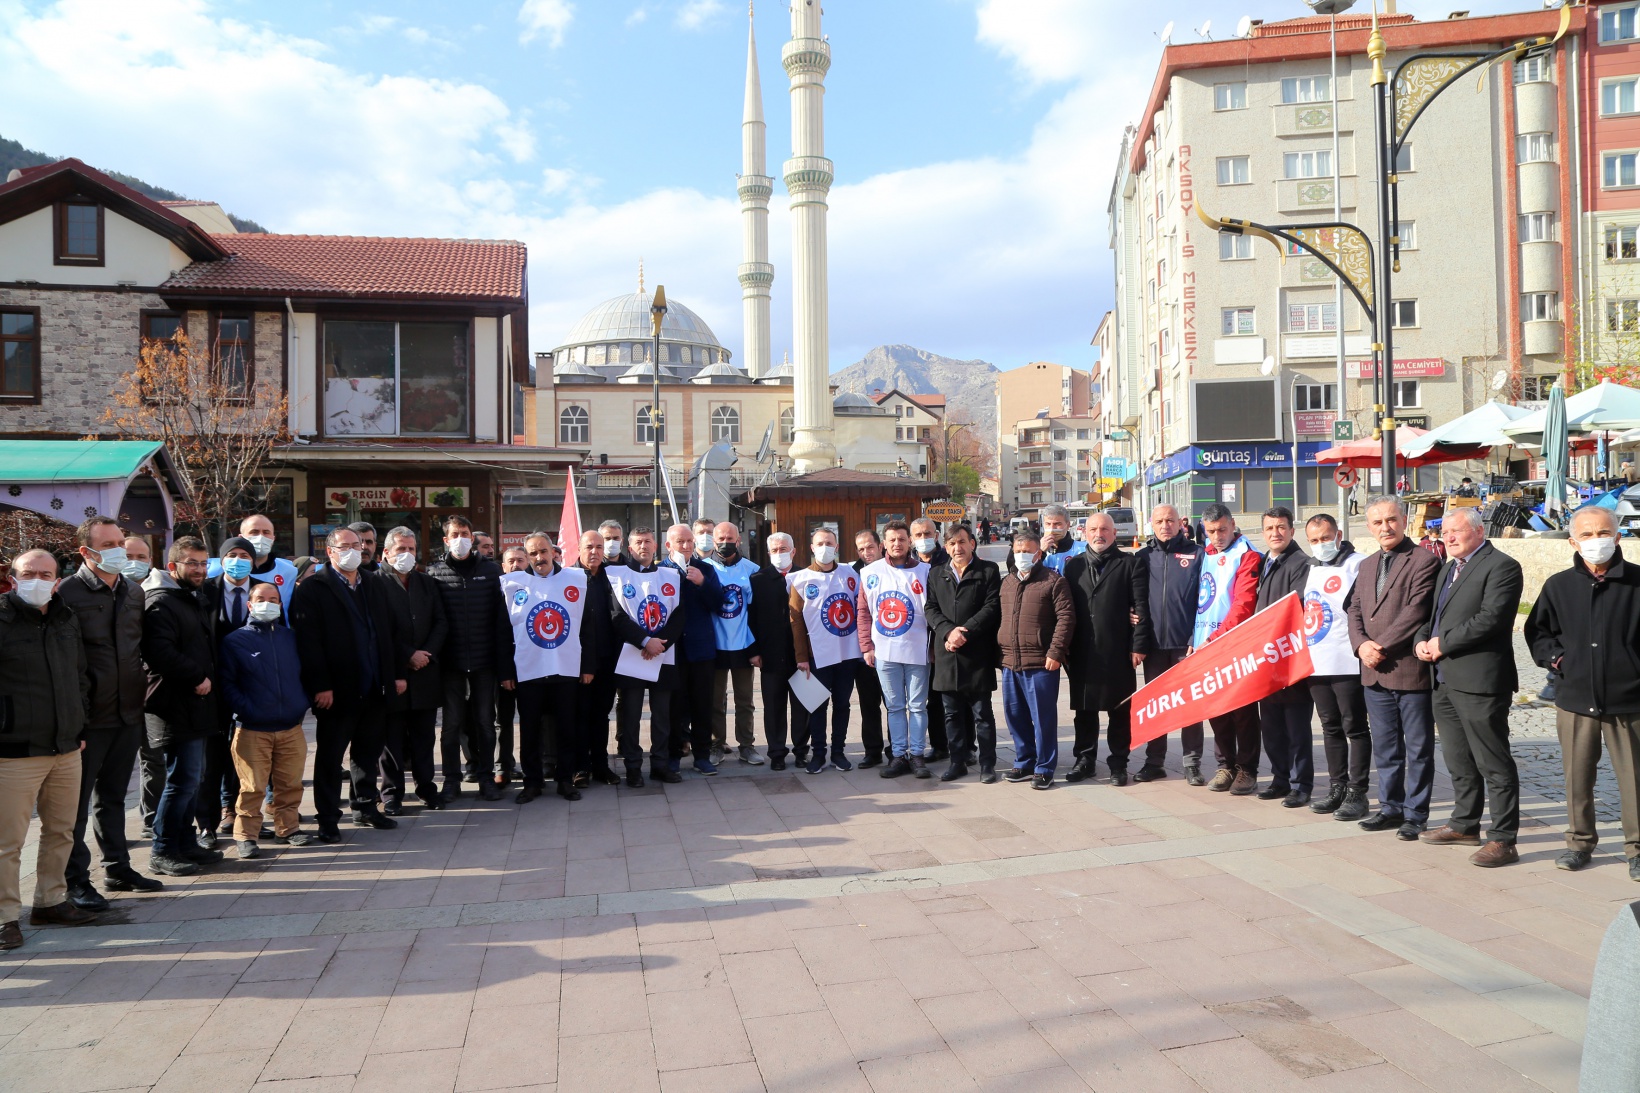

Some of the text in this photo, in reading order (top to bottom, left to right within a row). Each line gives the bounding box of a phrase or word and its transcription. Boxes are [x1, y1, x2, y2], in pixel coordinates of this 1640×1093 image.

[1179, 145, 1192, 216] AKSOY
[1183, 271, 1197, 375] MERKEZİ
[1407, 360, 1441, 369] CEMİYETİ
[1202, 450, 1251, 466] güntaş
[533, 602, 563, 614] SAĞLIK
[1136, 629, 1303, 725] TÜRK EĞİTİM-SEN
